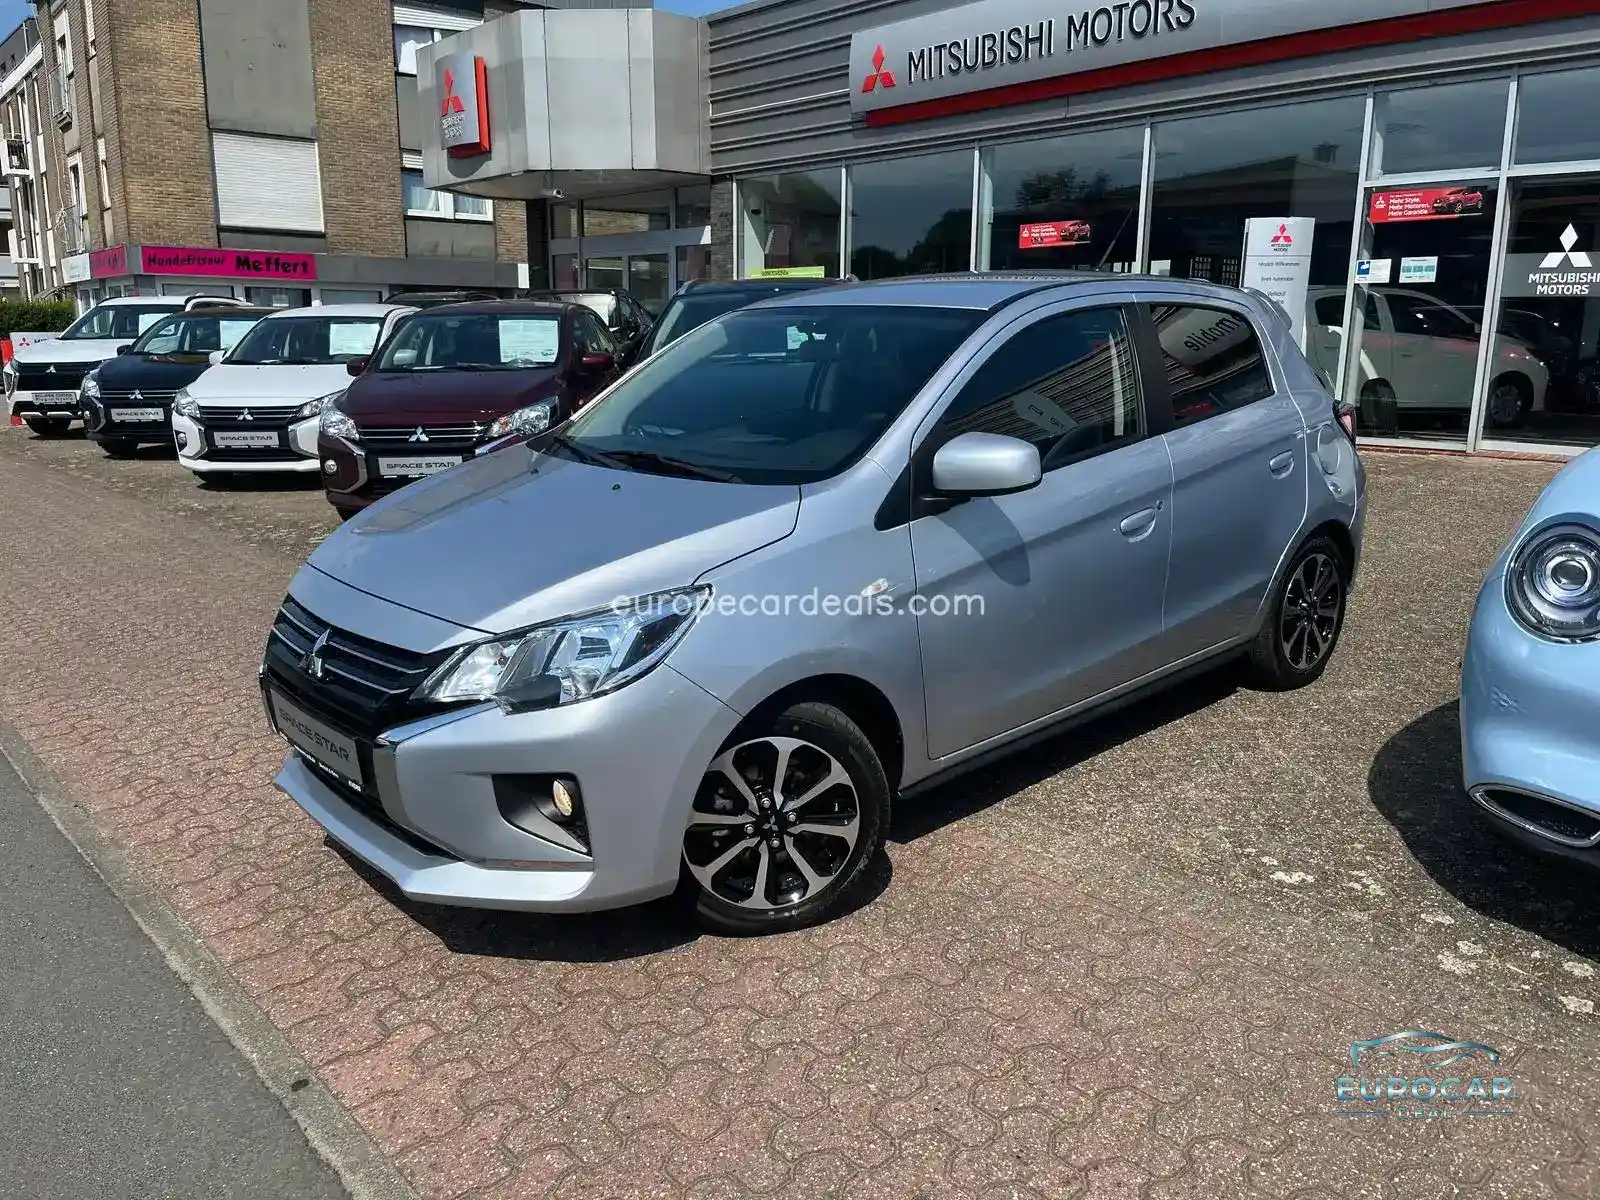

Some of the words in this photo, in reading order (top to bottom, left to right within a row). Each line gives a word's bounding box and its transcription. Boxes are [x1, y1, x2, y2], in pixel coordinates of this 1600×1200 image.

[908, 19, 1055, 84] MITSUBISHI
[1066, 0, 1197, 52] MOTORS
[235, 255, 309, 273] Meffert
[1528, 273, 1600, 284] MITSUBISHI
[1536, 284, 1590, 295] MOTORS
[425, 461, 456, 469] STAR
[279, 708, 314, 742] SPACE
[312, 732, 350, 761] STAR
